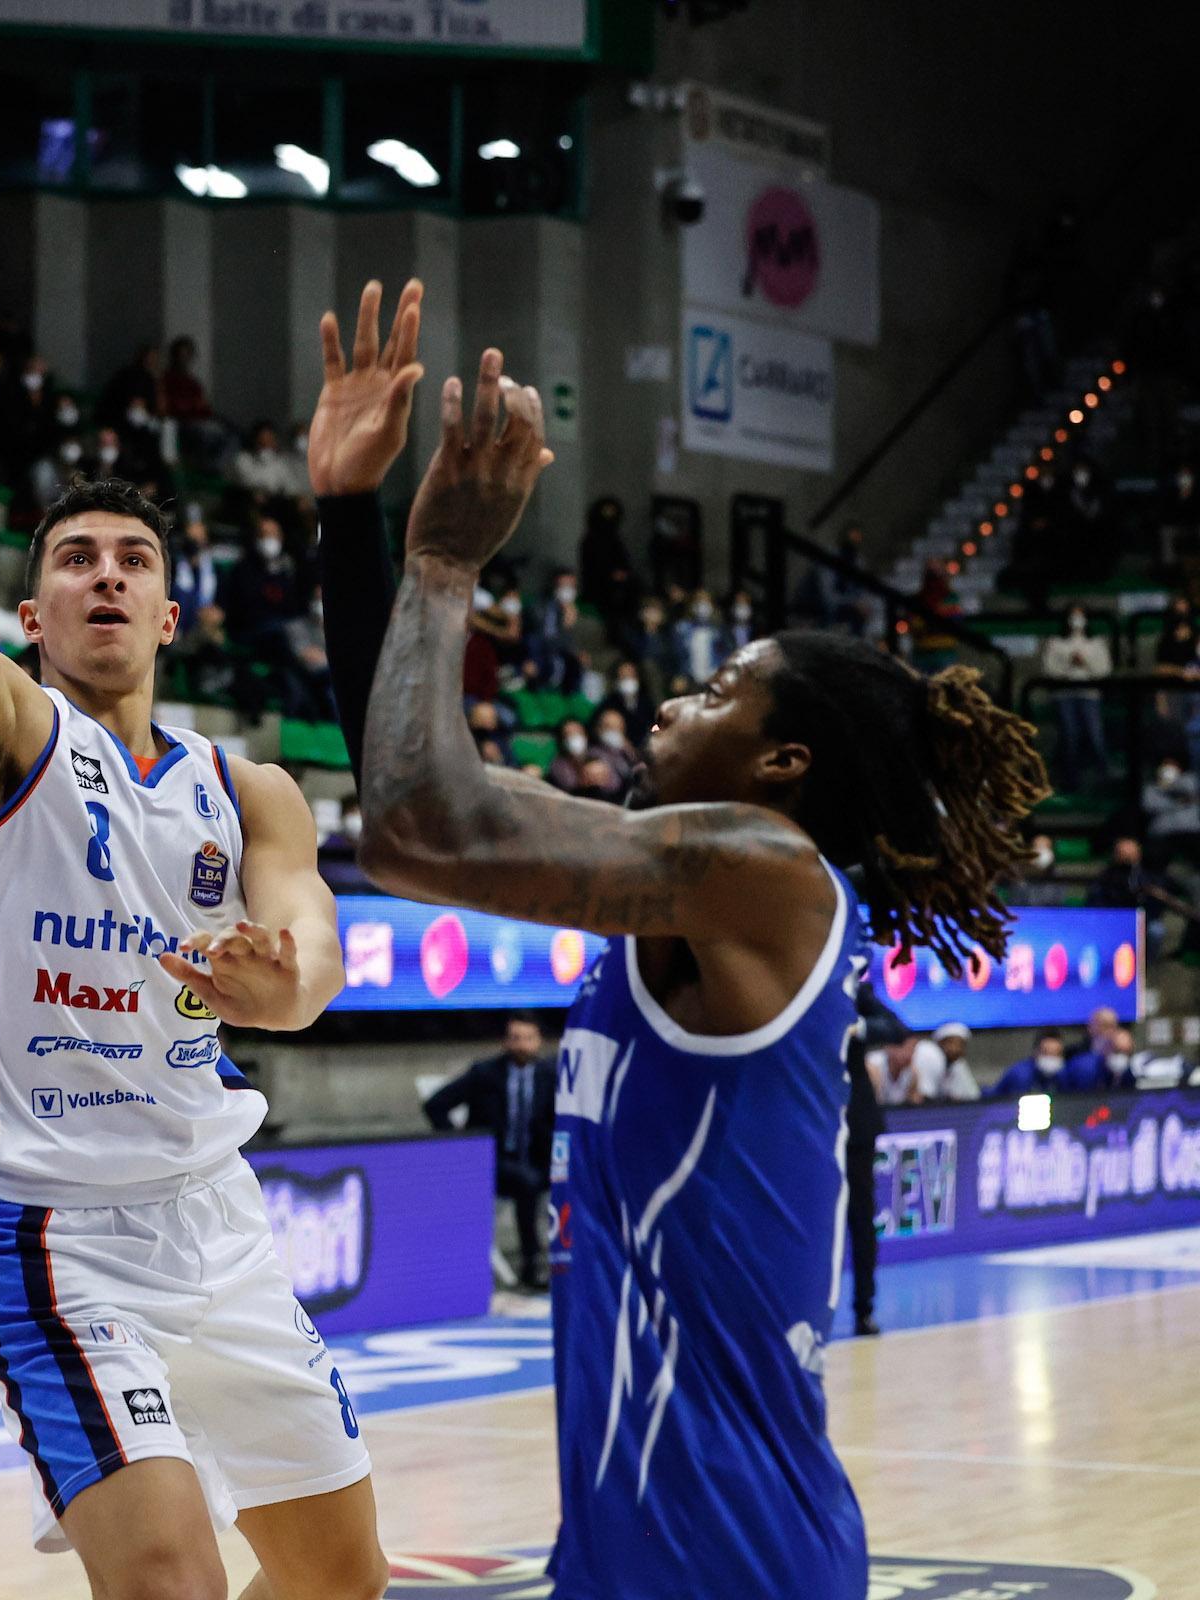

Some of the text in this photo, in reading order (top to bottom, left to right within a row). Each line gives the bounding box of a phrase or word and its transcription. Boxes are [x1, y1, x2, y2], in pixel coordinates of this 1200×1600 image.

[84, 801, 116, 882] 8
[196, 867, 223, 883] LBA
[67, 1089, 157, 1109] Volksbank
[329, 1366, 360, 1440] 8
